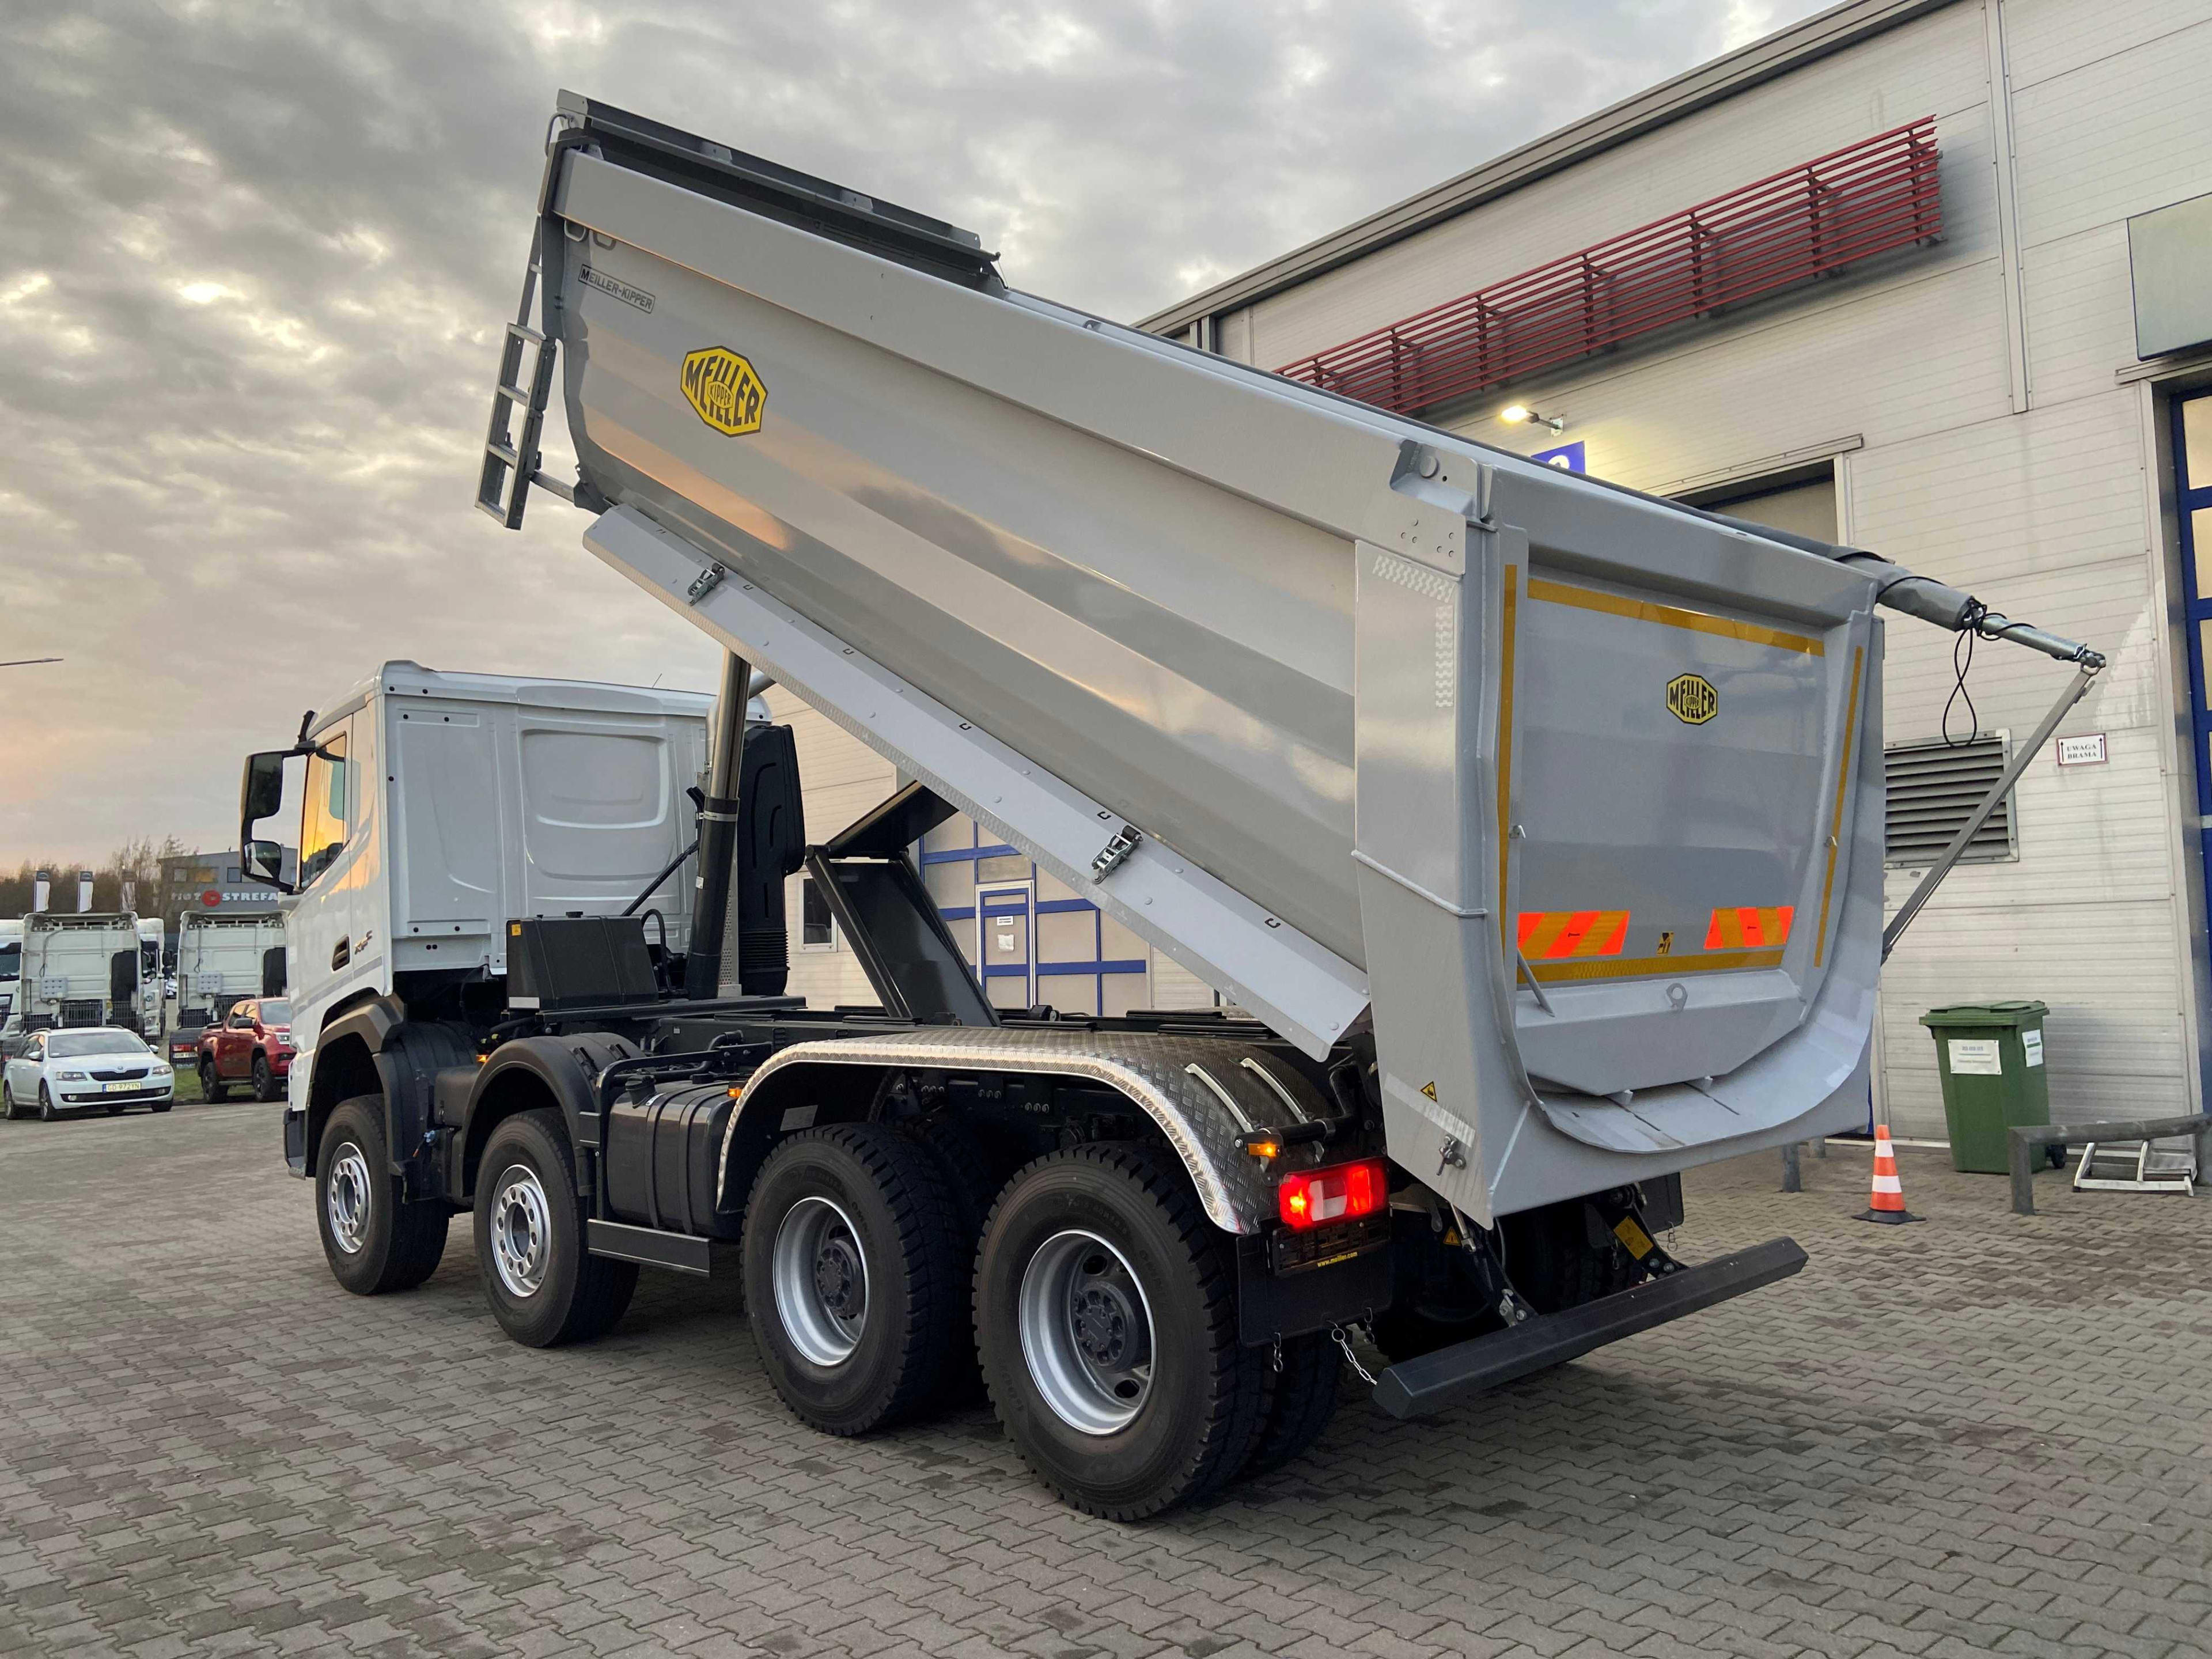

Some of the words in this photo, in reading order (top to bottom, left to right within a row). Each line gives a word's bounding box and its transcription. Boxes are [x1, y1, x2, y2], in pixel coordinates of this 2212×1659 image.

[581, 268, 652, 309] MEILLER-KIPPER
[685, 355, 760, 427] MEILLER
[710, 383, 731, 406] KIPPER
[1670, 679, 1715, 719] MEILLER
[2067, 744, 2097, 752] UWAGA
[2067, 751, 2097, 759] BRAMA
